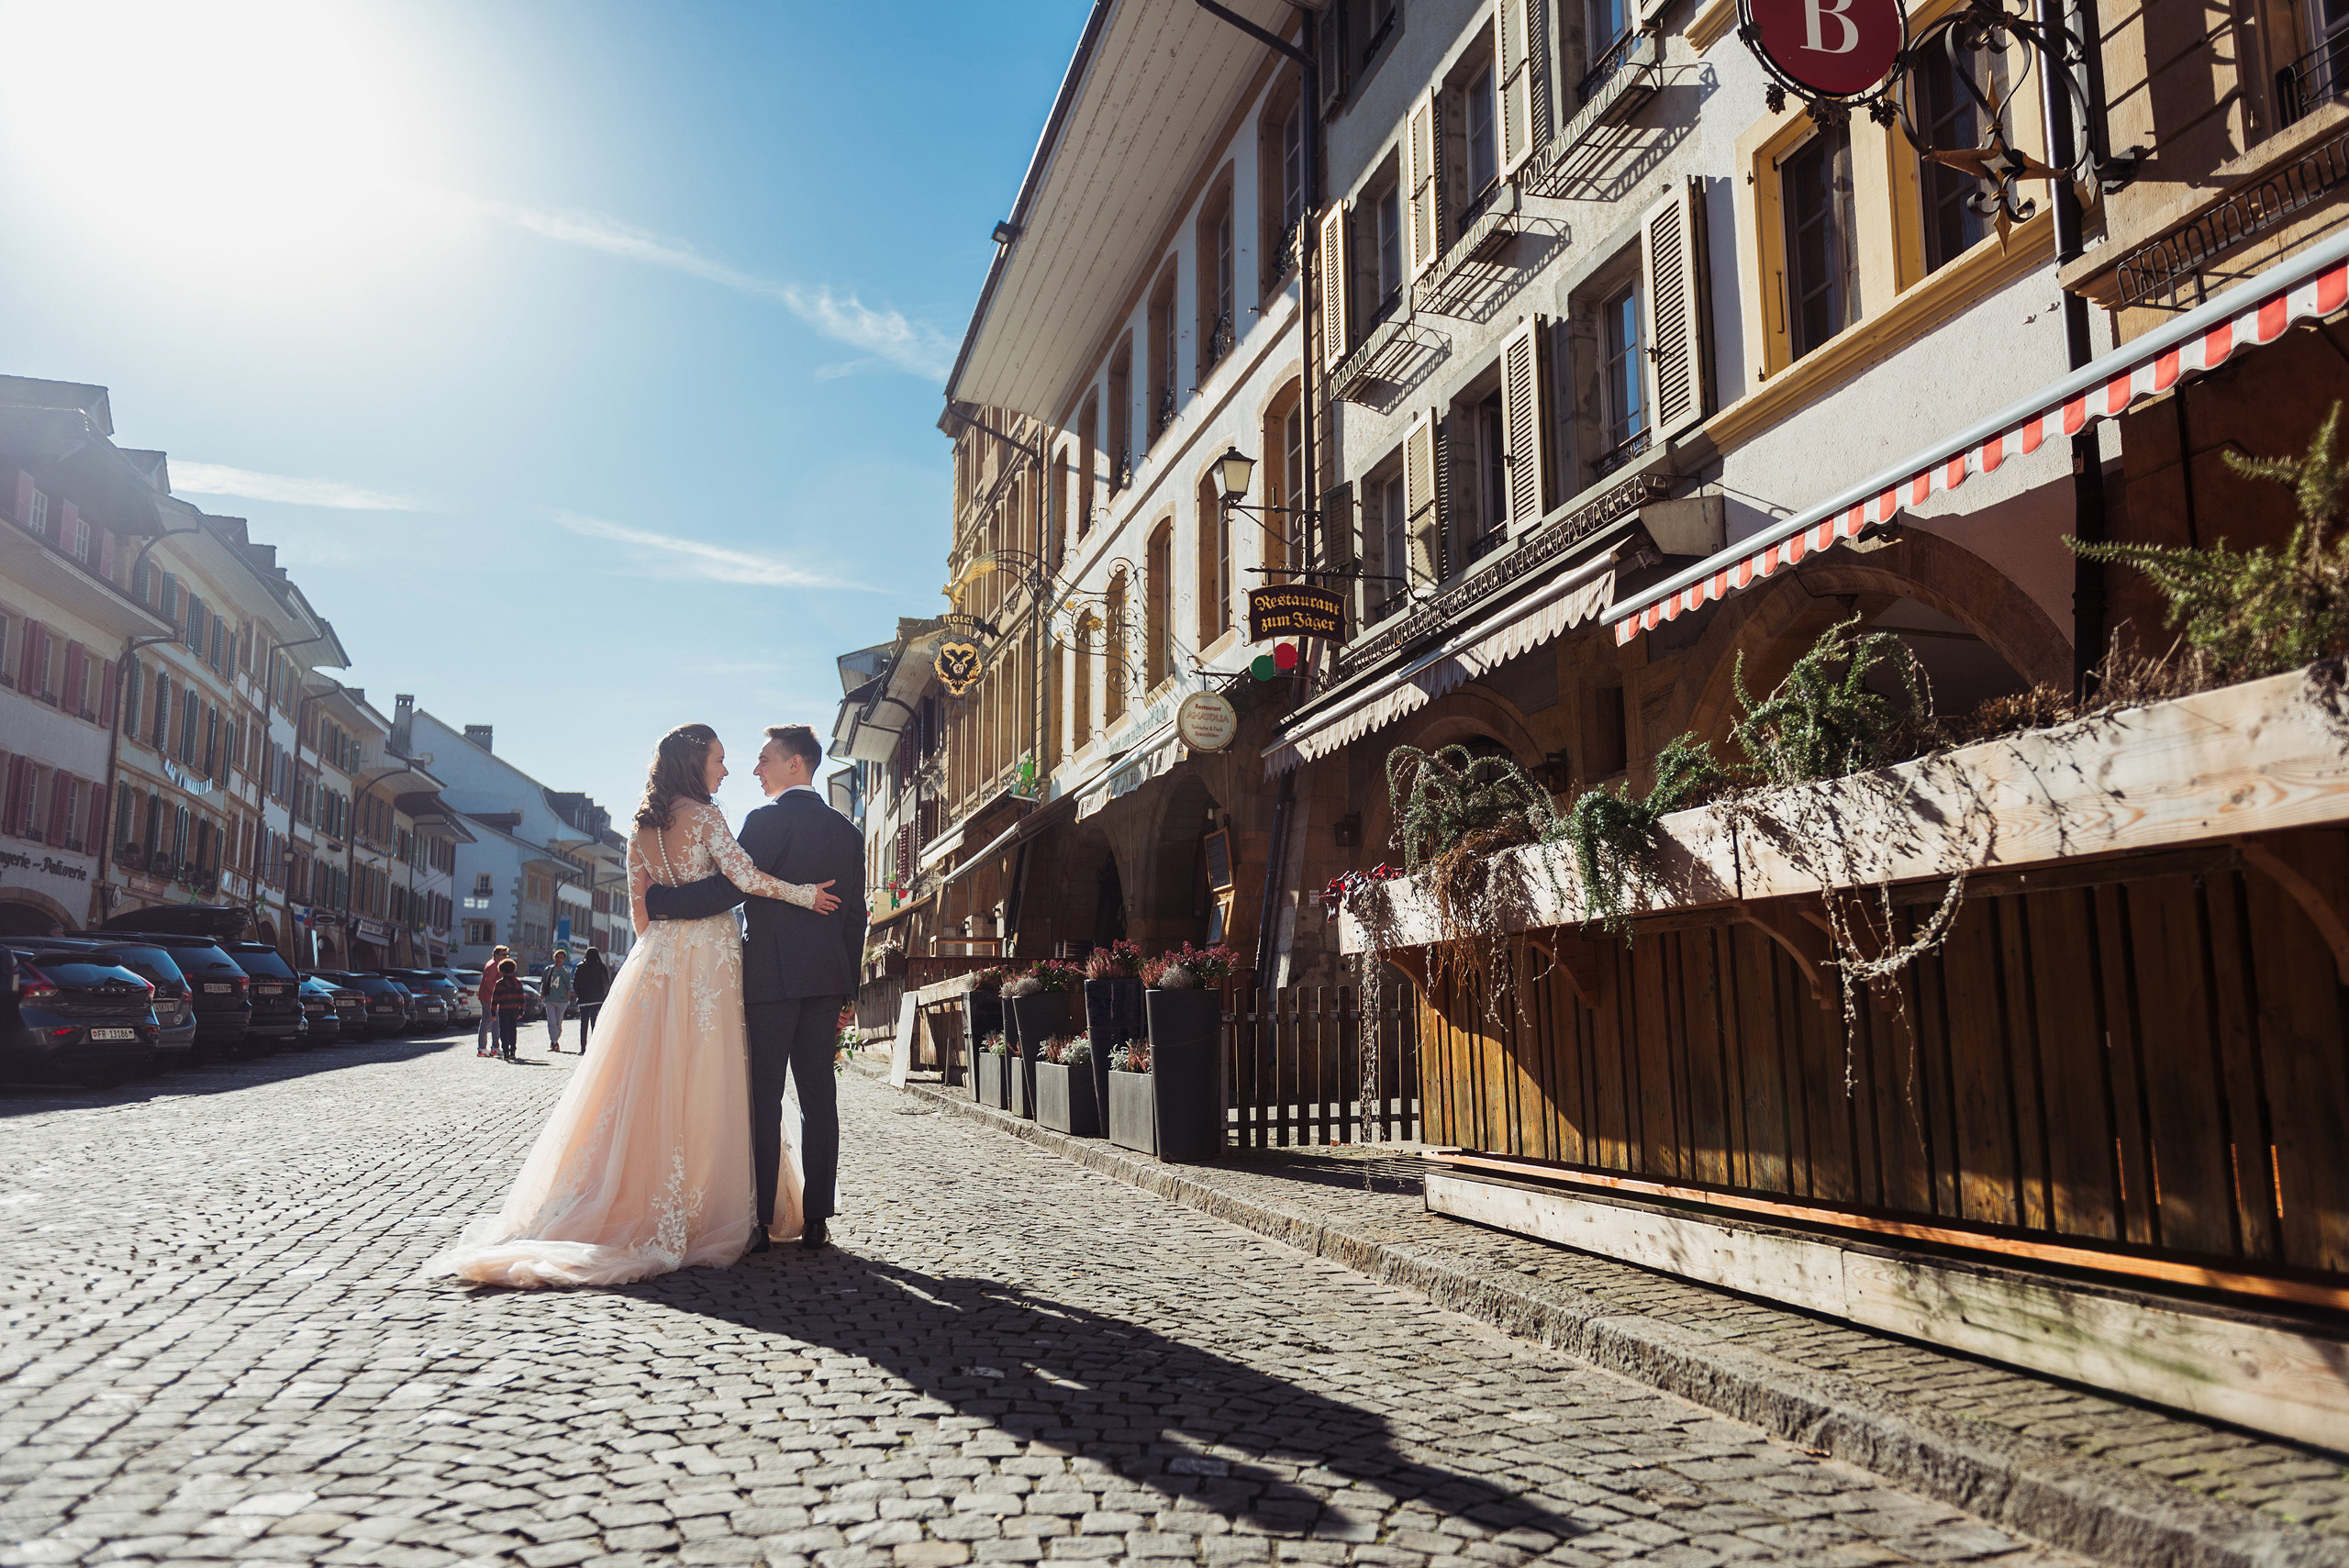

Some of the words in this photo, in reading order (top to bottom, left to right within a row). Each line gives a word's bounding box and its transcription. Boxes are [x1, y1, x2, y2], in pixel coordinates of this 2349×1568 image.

[1800, 0, 1859, 53] B
[1254, 593, 1340, 616] Restaurant
[1261, 615, 1291, 632] zum
[1292, 611, 1336, 631] Jäger
[1186, 711, 1230, 723] ANATOLIA
[1195, 703, 1221, 711] Restaurant
